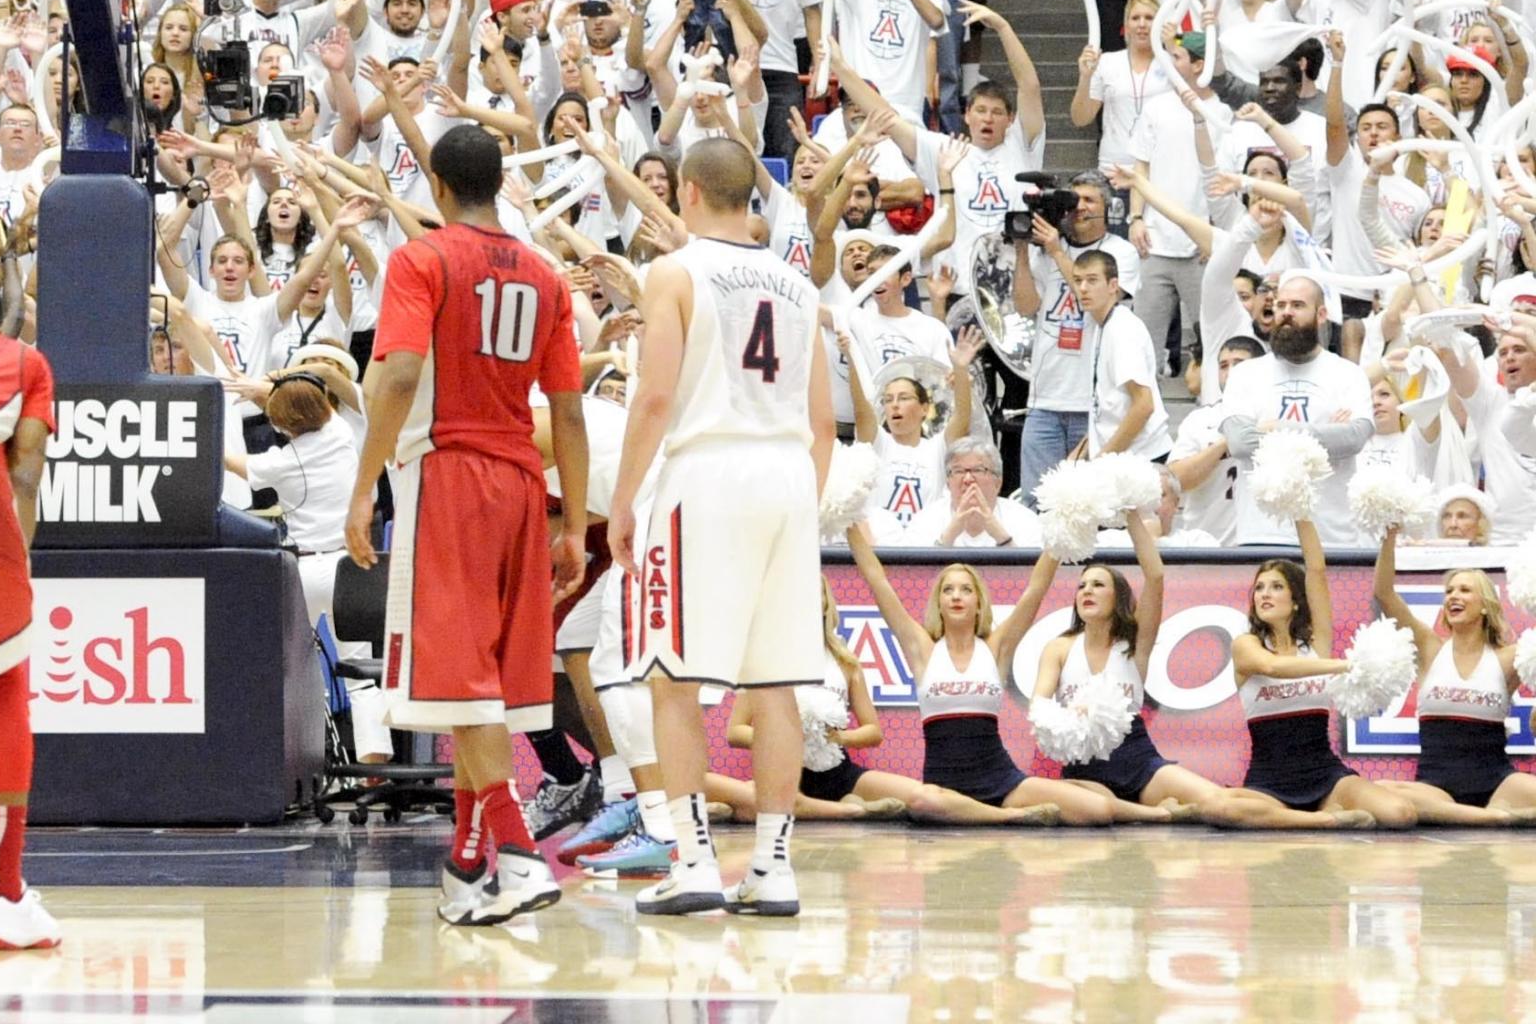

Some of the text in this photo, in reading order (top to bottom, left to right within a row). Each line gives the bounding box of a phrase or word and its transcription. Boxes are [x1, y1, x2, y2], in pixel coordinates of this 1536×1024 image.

[869, 10, 905, 47] A
[968, 173, 1010, 211] A
[710, 266, 804, 308] McCONNELL
[1045, 283, 1084, 322] A
[474, 276, 541, 364] 10
[742, 300, 780, 383] 4
[45, 399, 197, 458] USCLE
[35, 461, 162, 522] MILK
[648, 545, 669, 630] CATS
[26, 606, 192, 705] ish
